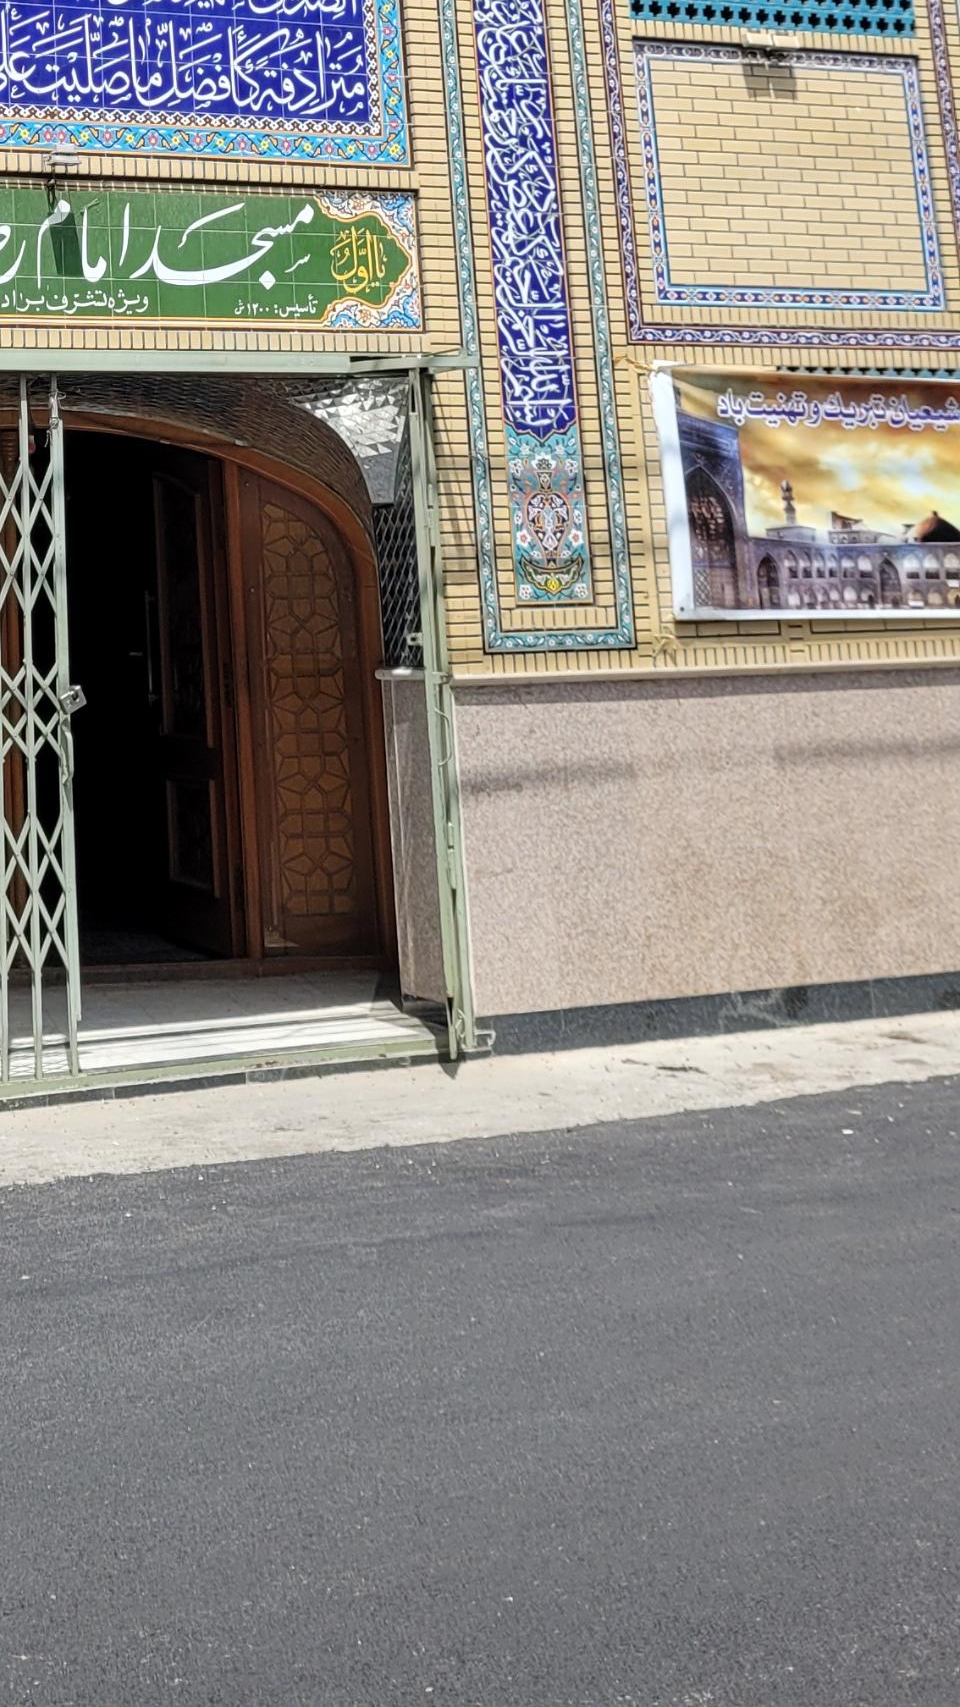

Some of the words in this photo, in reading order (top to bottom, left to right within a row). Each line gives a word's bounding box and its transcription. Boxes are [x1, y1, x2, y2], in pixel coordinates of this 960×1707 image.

[135, 203, 314, 288] مسجد
[107, 288, 149, 317] ویژه
[716, 387, 746, 425] باد
[744, 391, 808, 428] تهنیت
[823, 391, 888, 429] تبریک
